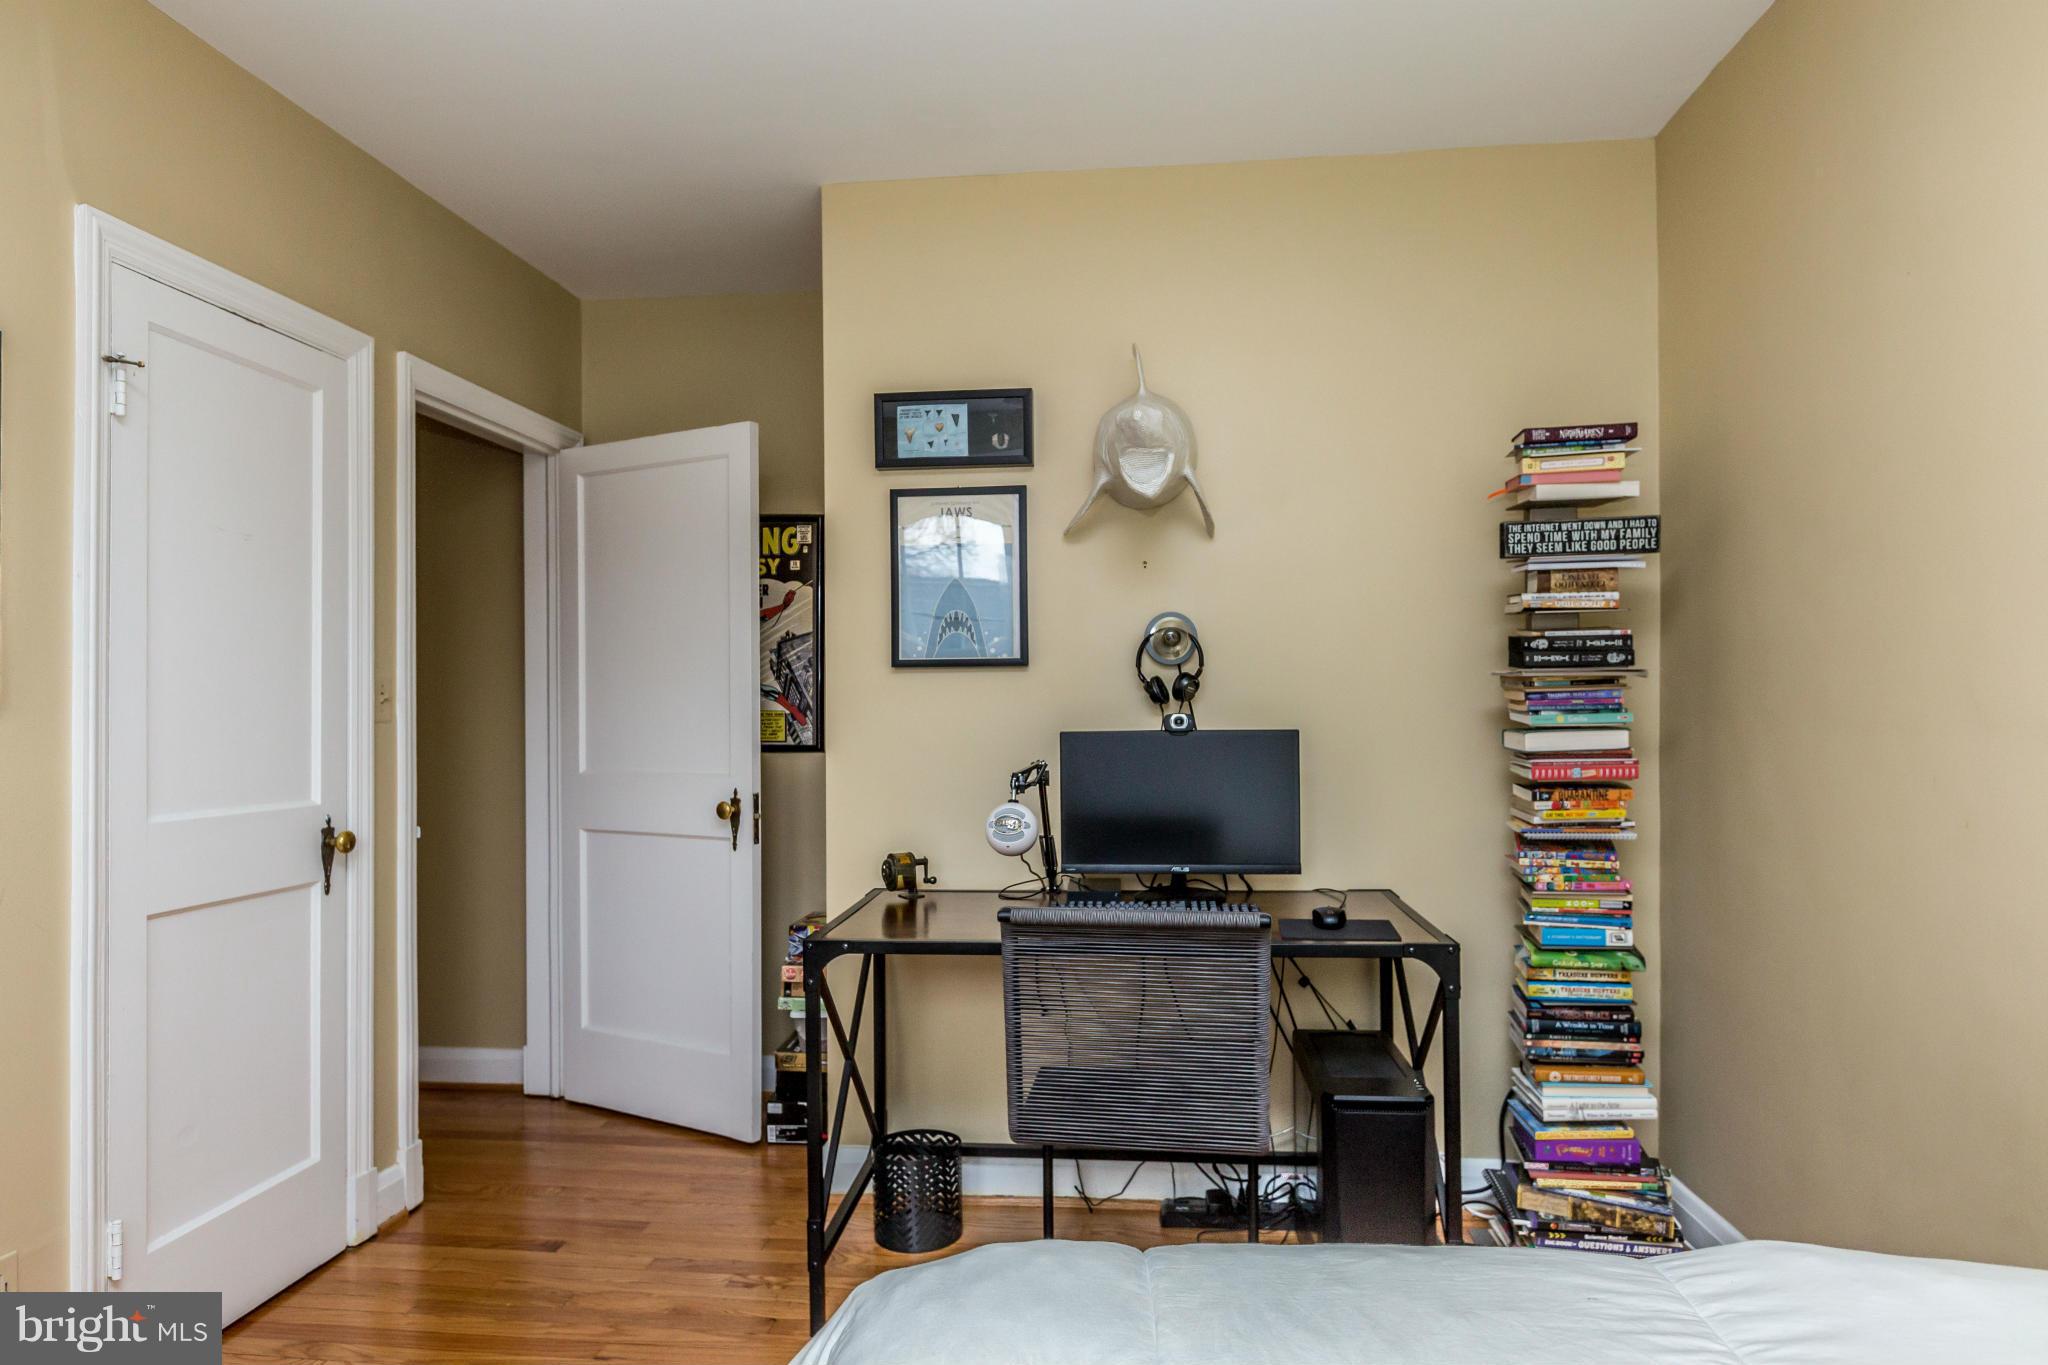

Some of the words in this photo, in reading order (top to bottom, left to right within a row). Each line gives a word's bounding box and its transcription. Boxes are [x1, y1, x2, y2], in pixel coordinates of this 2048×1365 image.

[941, 507, 973, 518] JAWS
[1508, 524, 1521, 534] THE
[1524, 522, 1559, 533] INTERNET
[1561, 521, 1581, 532] WENT
[1584, 520, 1605, 531] DOWN
[1607, 519, 1623, 530] AND
[1629, 519, 1645, 528] HAD
[1647, 518, 1657, 528] TO
[1508, 532, 1540, 544] SPEND
[1544, 531, 1568, 543] TIME
[1571, 530, 1597, 542] WITH
[1601, 529, 1616, 540] MY
[1619, 527, 1657, 539] FAMILY
[1508, 543, 1533, 554] THEY
[1536, 541, 1562, 553] SEEM
[1565, 540, 1588, 552] LIKE
[1590, 539, 1616, 551] GOOD
[1619, 538, 1657, 550] PEOPLE
[1559, 789, 1608, 801] QUARANTINE
[1578, 1241, 1624, 1252] QUESTIONS
[1632, 1244, 1673, 1254] ANSWERS
